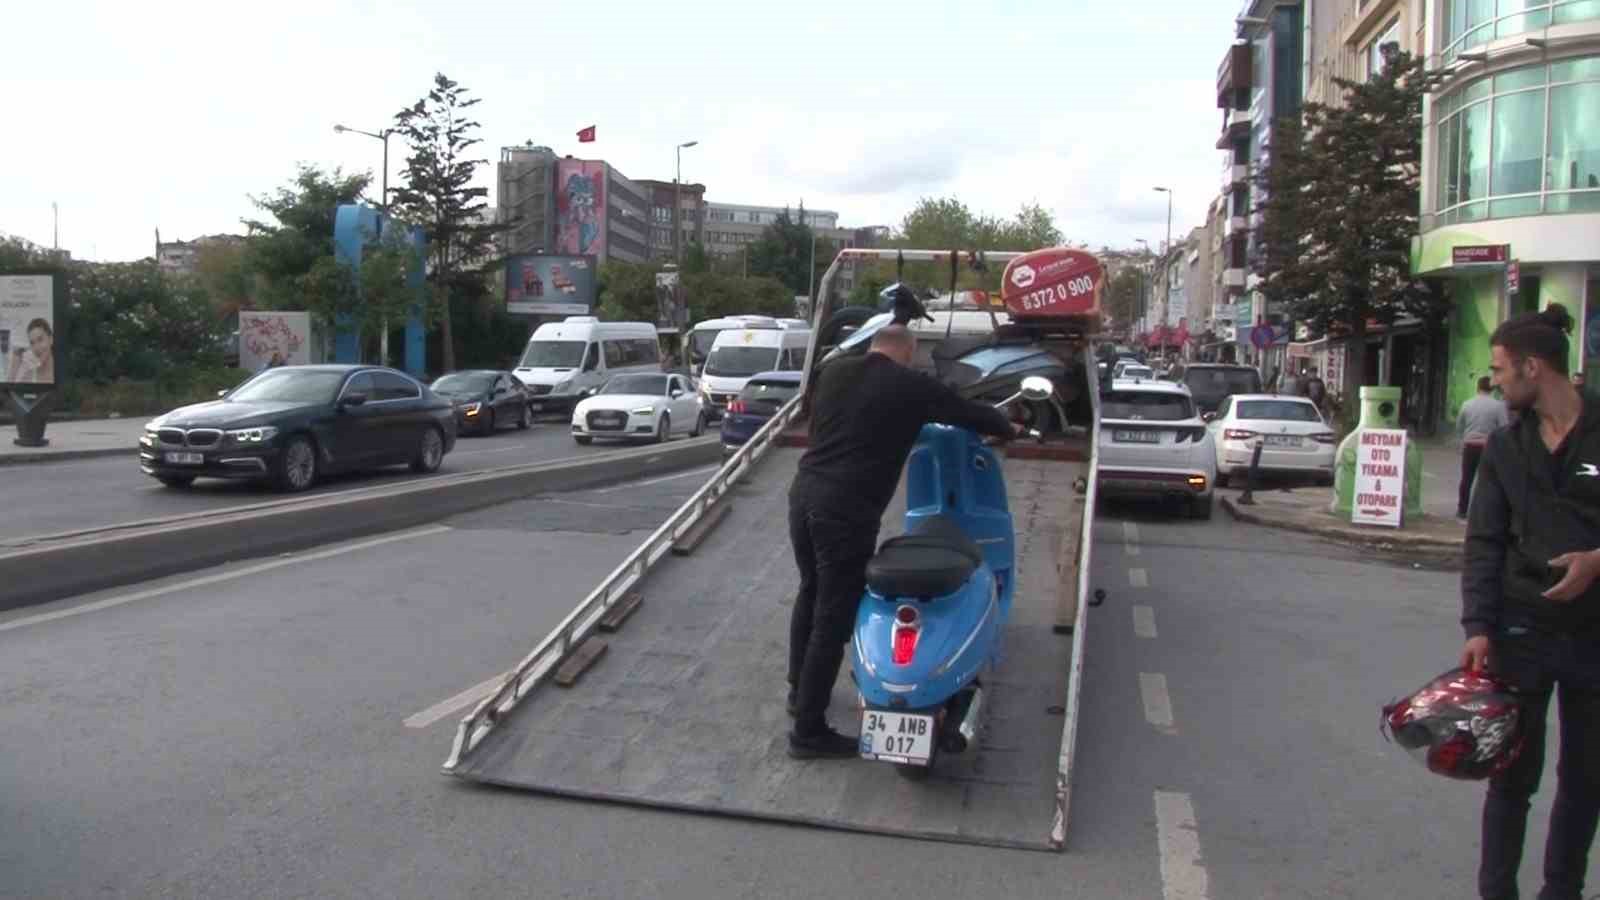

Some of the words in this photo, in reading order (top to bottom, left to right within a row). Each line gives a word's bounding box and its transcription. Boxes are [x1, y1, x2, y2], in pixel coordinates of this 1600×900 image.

[1031, 288, 1056, 309] 372
[1057, 283, 1067, 301] 0
[1068, 275, 1094, 297] 900
[1361, 432, 1402, 446] MEYDAN
[1371, 448, 1391, 461] OTO
[1362, 464, 1399, 477] YIKAMA
[1357, 493, 1397, 507] OTOPARK
[868, 714, 886, 732] 34
[898, 717, 927, 736] ANB
[886, 735, 915, 754] 017
